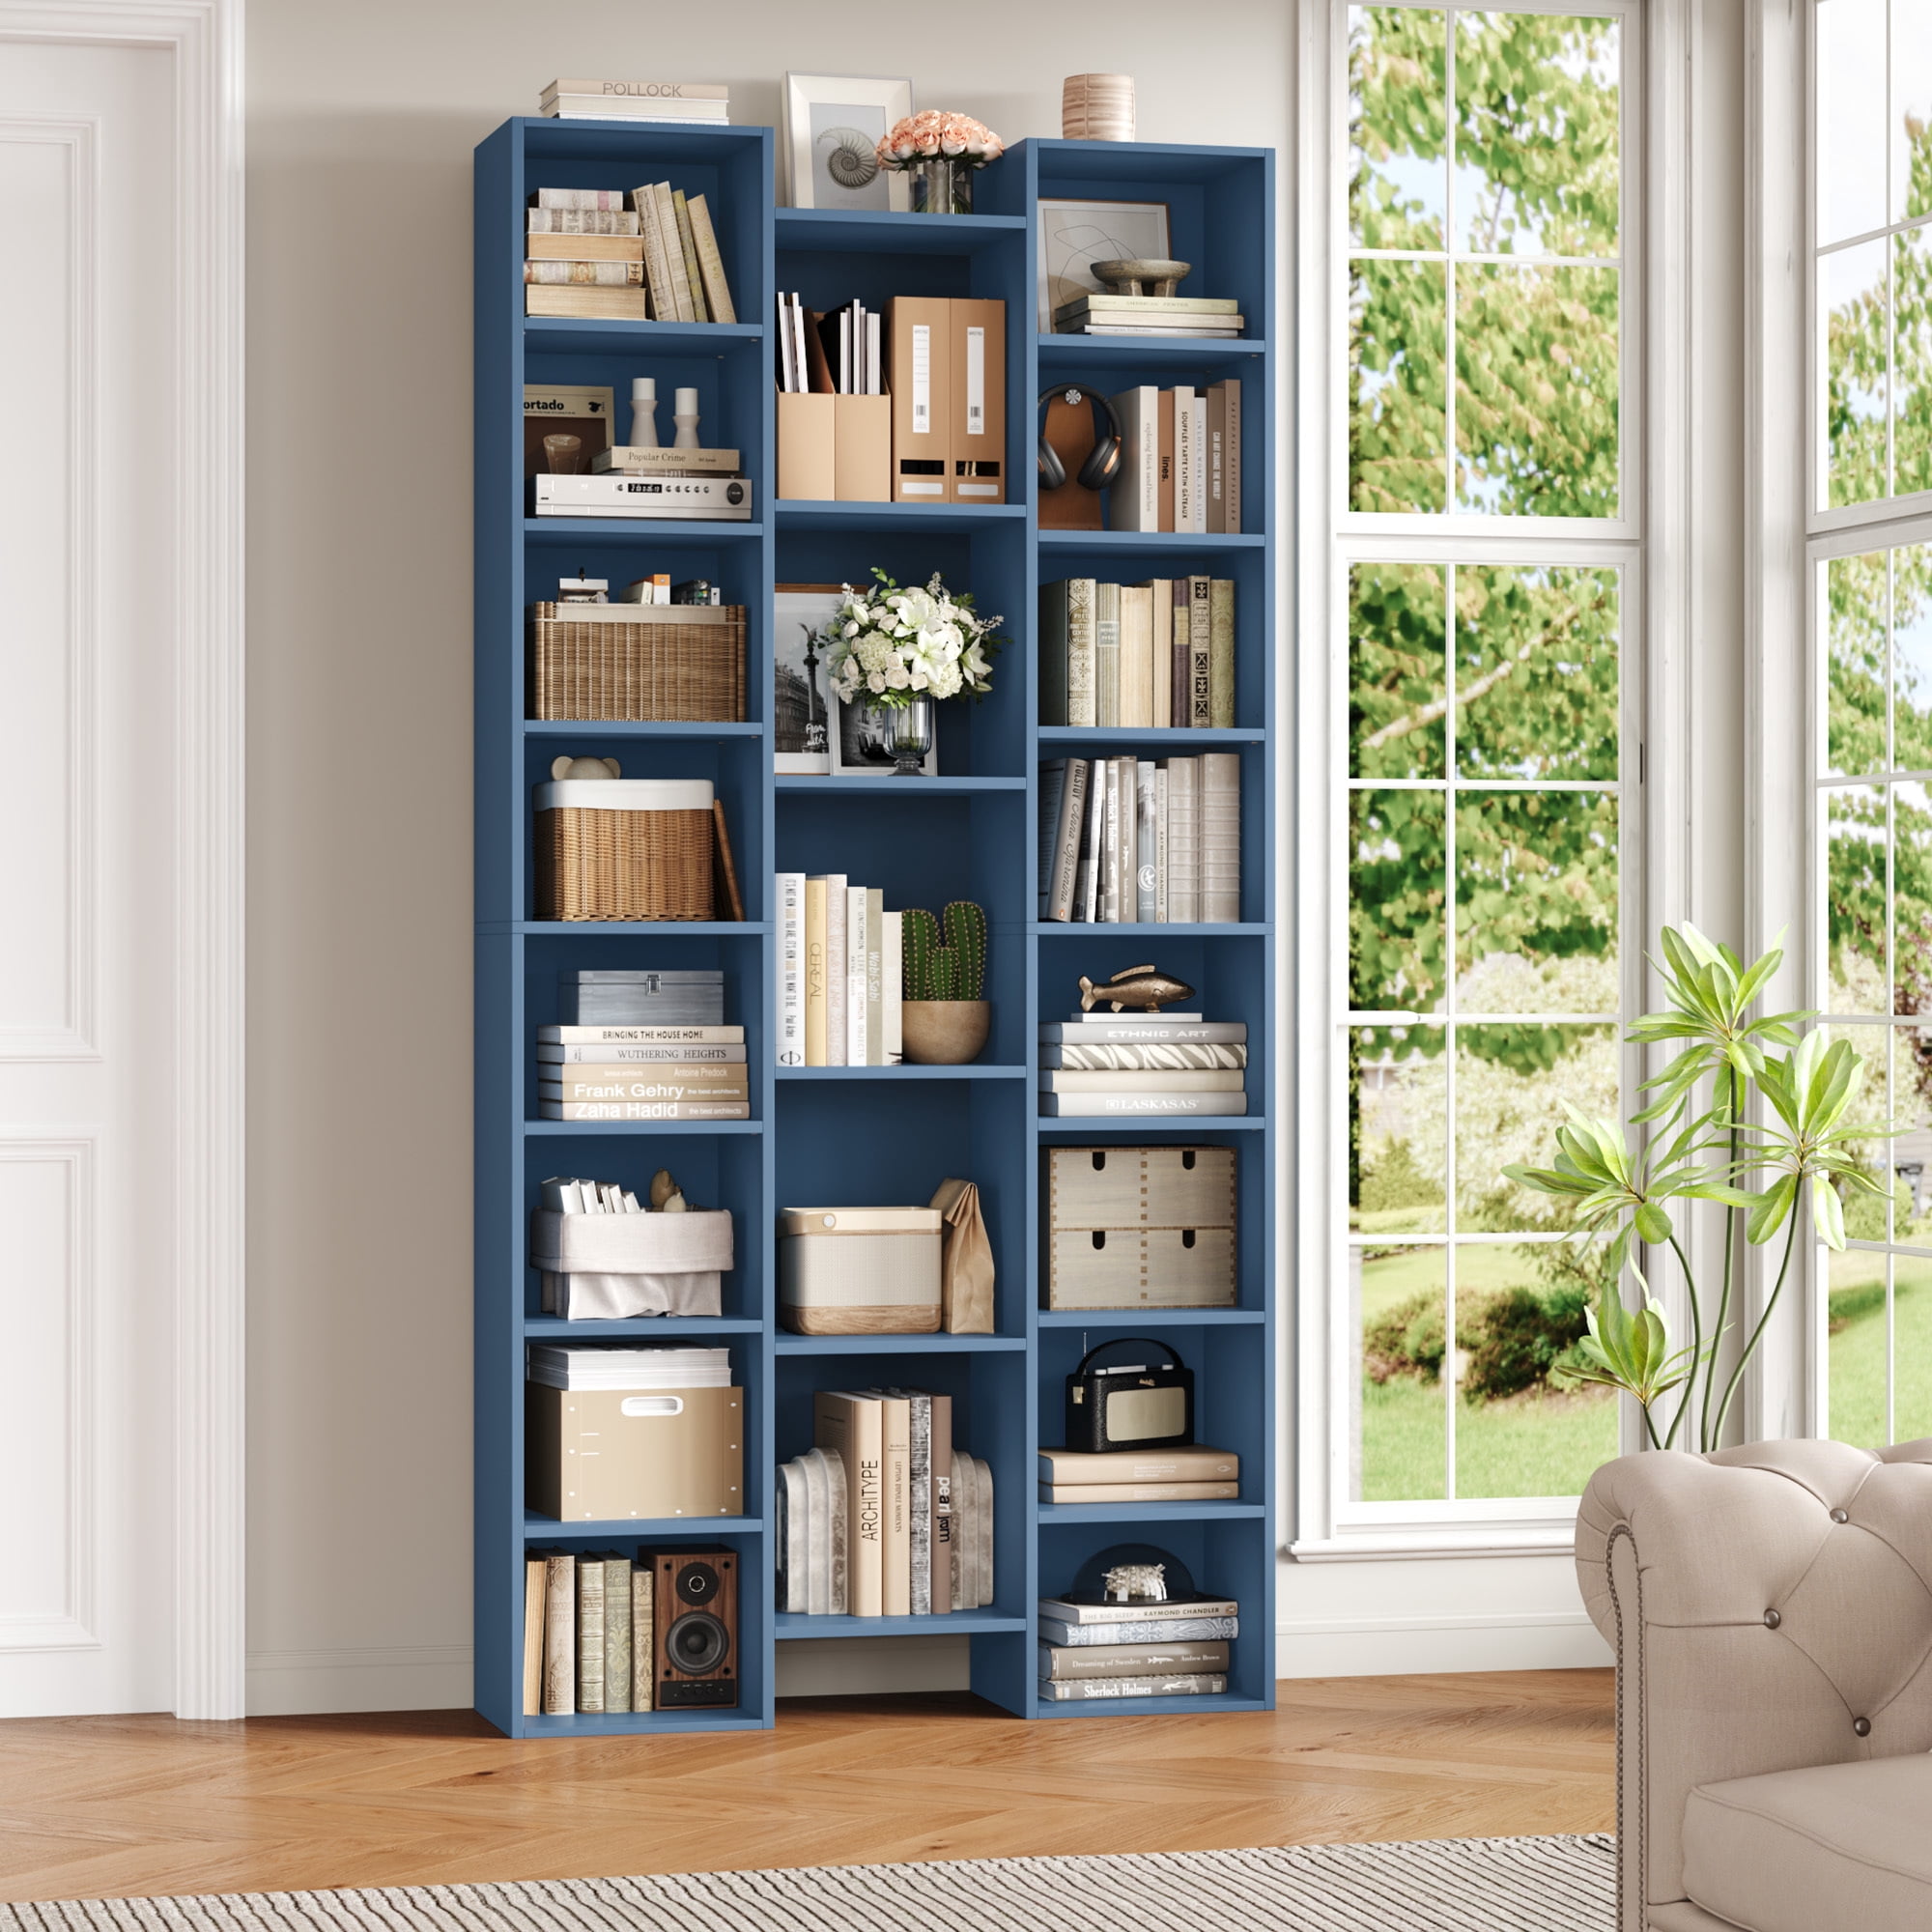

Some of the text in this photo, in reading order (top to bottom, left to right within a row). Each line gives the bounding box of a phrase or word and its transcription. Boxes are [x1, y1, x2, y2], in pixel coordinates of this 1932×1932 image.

[603, 82, 682, 98] POLLOCK
[1144, 422, 1153, 452] exploring
[628, 451, 660, 463] Popular
[661, 452, 687, 463] Crime
[1161, 456, 1171, 482] lines.
[1107, 787, 1118, 851] Sherlock Holmes
[1061, 764, 1086, 904] TOLSTOY Anna Karenina
[857, 894, 866, 906] THE
[857, 911, 866, 950] UNCOMMON
[857, 953, 866, 974] LIFE
[810, 942, 822, 1005] CEREAL
[857, 991, 866, 1021] COMMON
[603, 1030, 703, 1039] BRINGING THE HOUSE HOME
[857, 1024, 866, 1059] OBJECTS
[1107, 1030, 1170, 1038] ETHNIC
[617, 1049, 727, 1059] WUTHERING HEIGHTS
[673, 1067, 728, 1077] Antoine Predock
[574, 1084, 625, 1097] Frank
[631, 1083, 684, 1100] Gehry
[575, 1102, 620, 1118] Zaha
[626, 1102, 678, 1118] Hadid
[1121, 1099, 1198, 1110] LASKASAS
[861, 1460, 878, 1541] ARCHITYPE
[936, 1476, 952, 1513] pearl
[1143, 1608, 1180, 1617] RAYMOND
[1182, 1606, 1220, 1615] CHANDLER
[1072, 1660, 1105, 1669] Dreaming
[1115, 1658, 1141, 1666] Sweden
[1084, 1685, 1152, 1697] Sherlock Holmes
